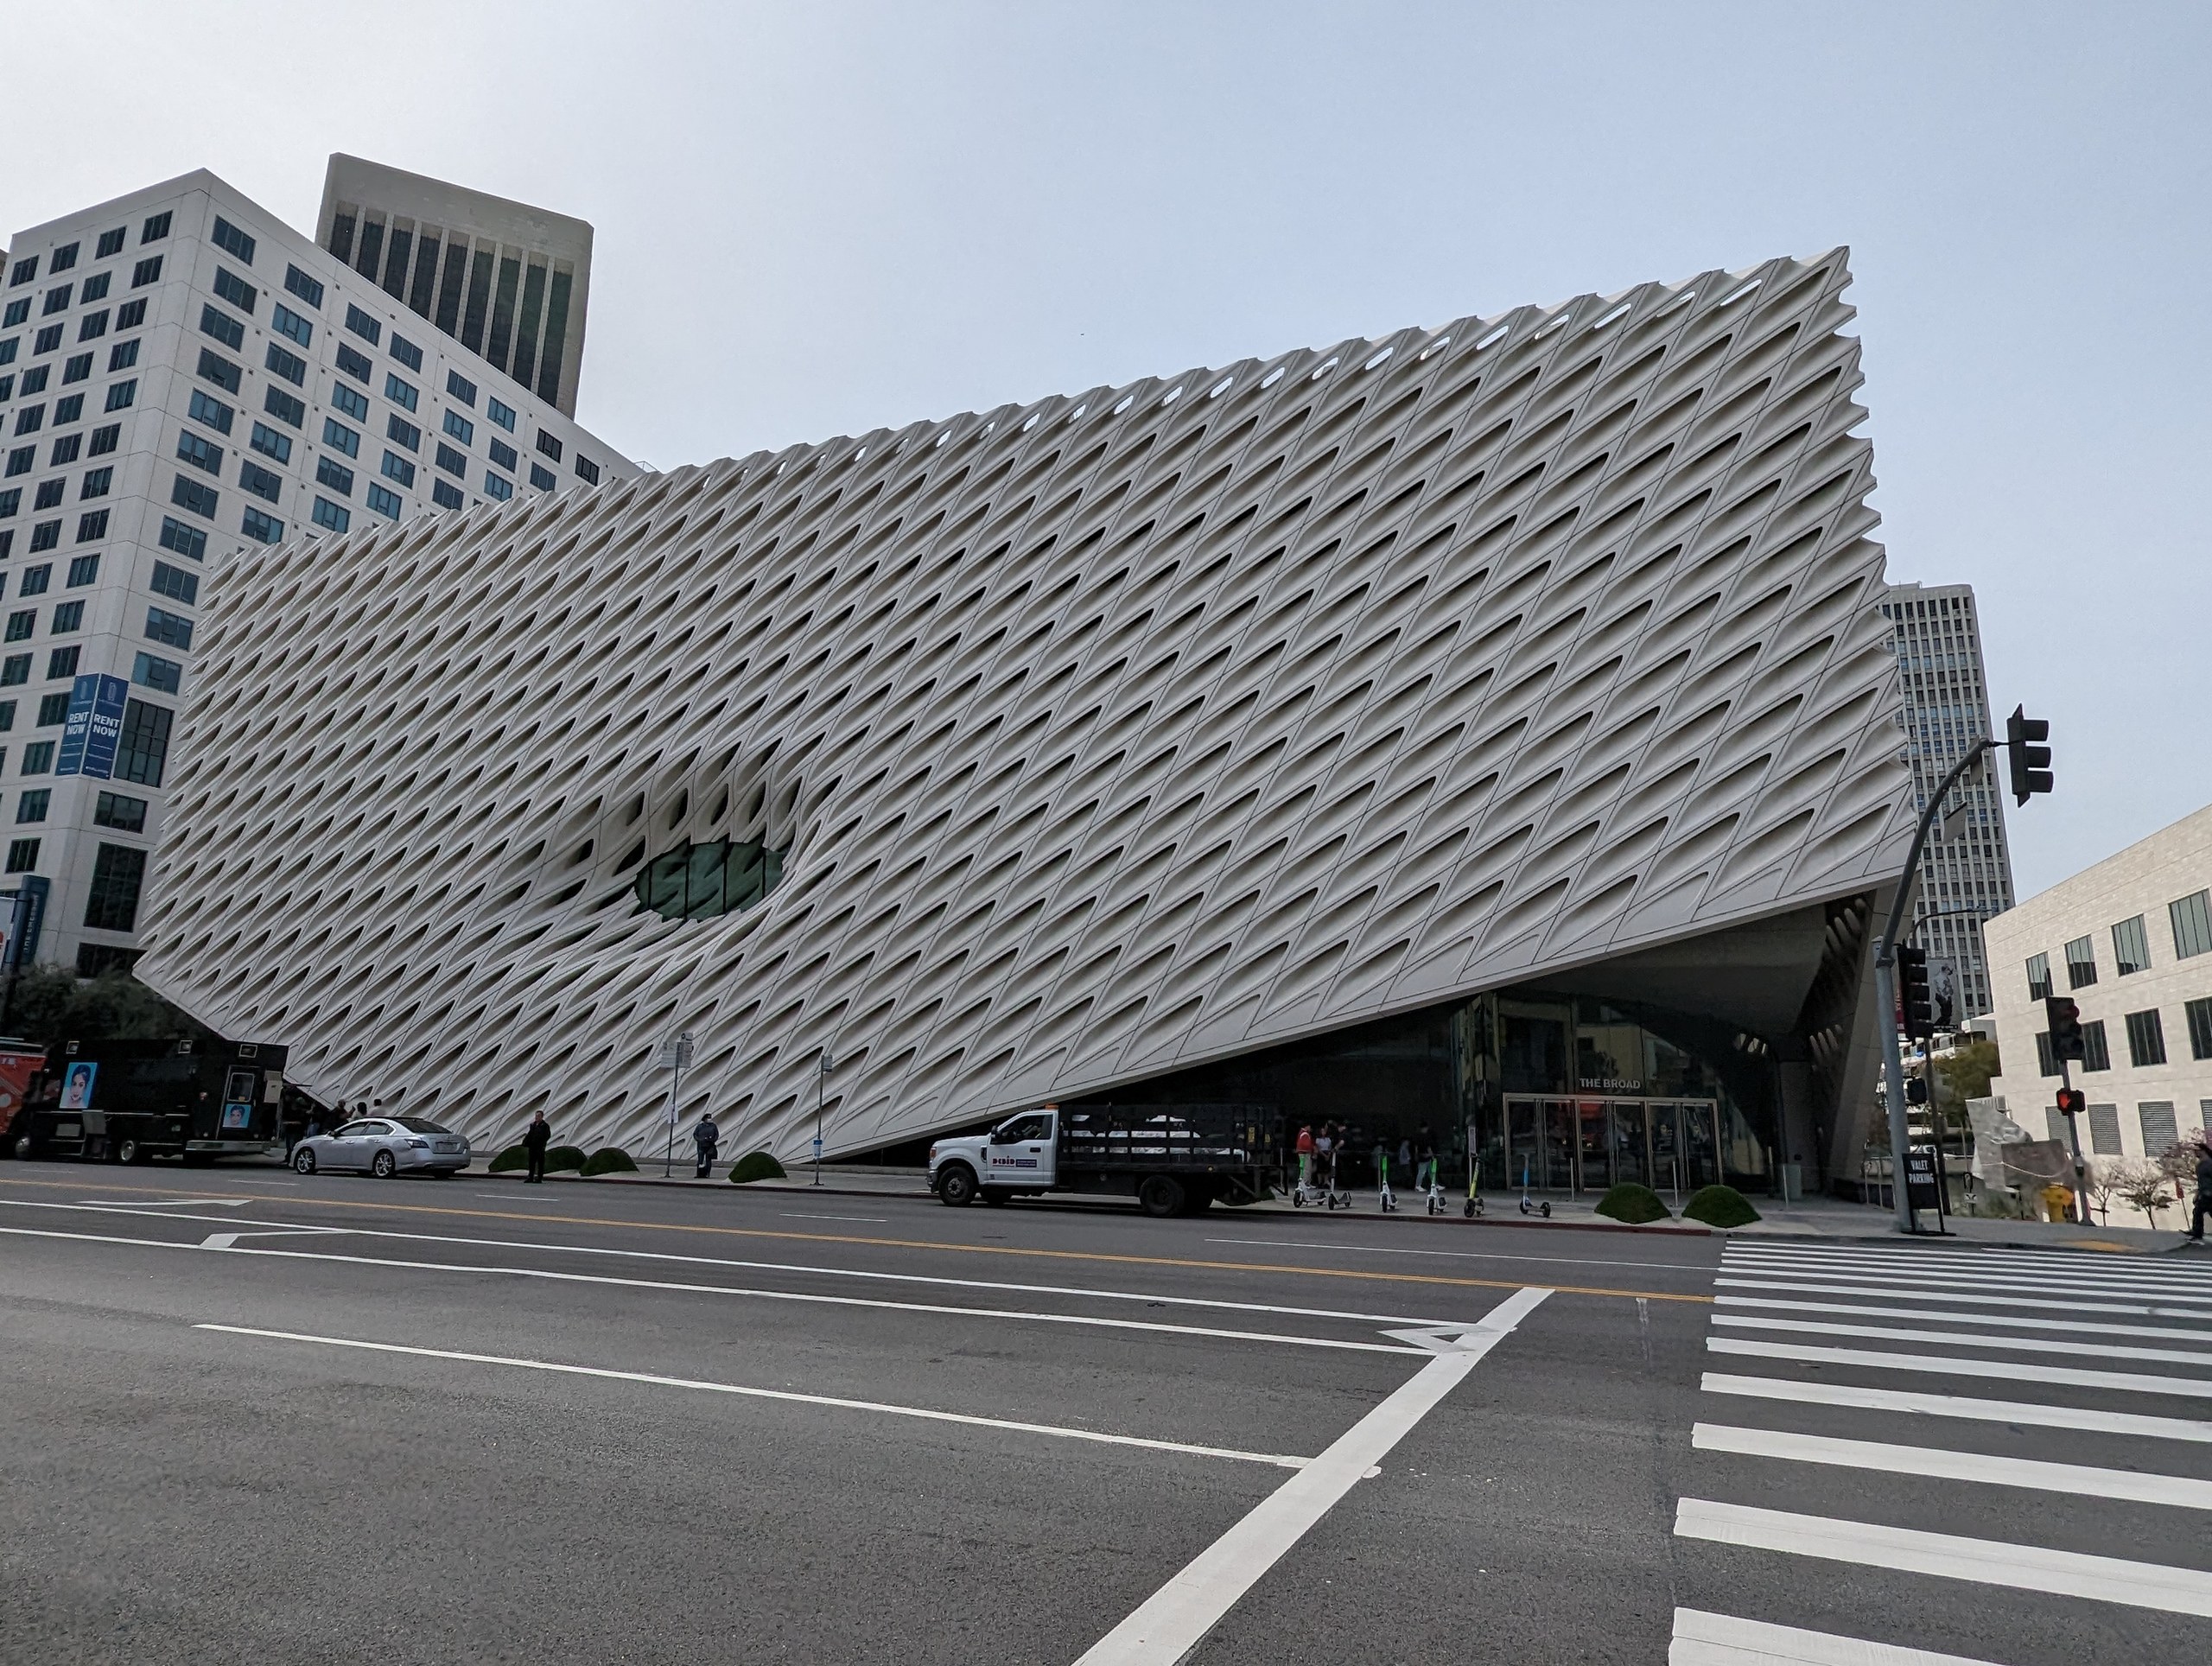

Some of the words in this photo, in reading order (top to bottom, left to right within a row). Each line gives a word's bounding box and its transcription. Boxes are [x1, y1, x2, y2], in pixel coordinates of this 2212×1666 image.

[68, 711, 90, 723] RENT
[93, 713, 120, 727] RENT
[67, 723, 86, 735] NOW
[92, 724, 118, 738] NOW
[1579, 1078, 1602, 1088] THE
[1603, 1078, 1641, 1089] BROAD
[1910, 1159, 1928, 1171] VALET
[1908, 1173, 1935, 1184] PARKING
